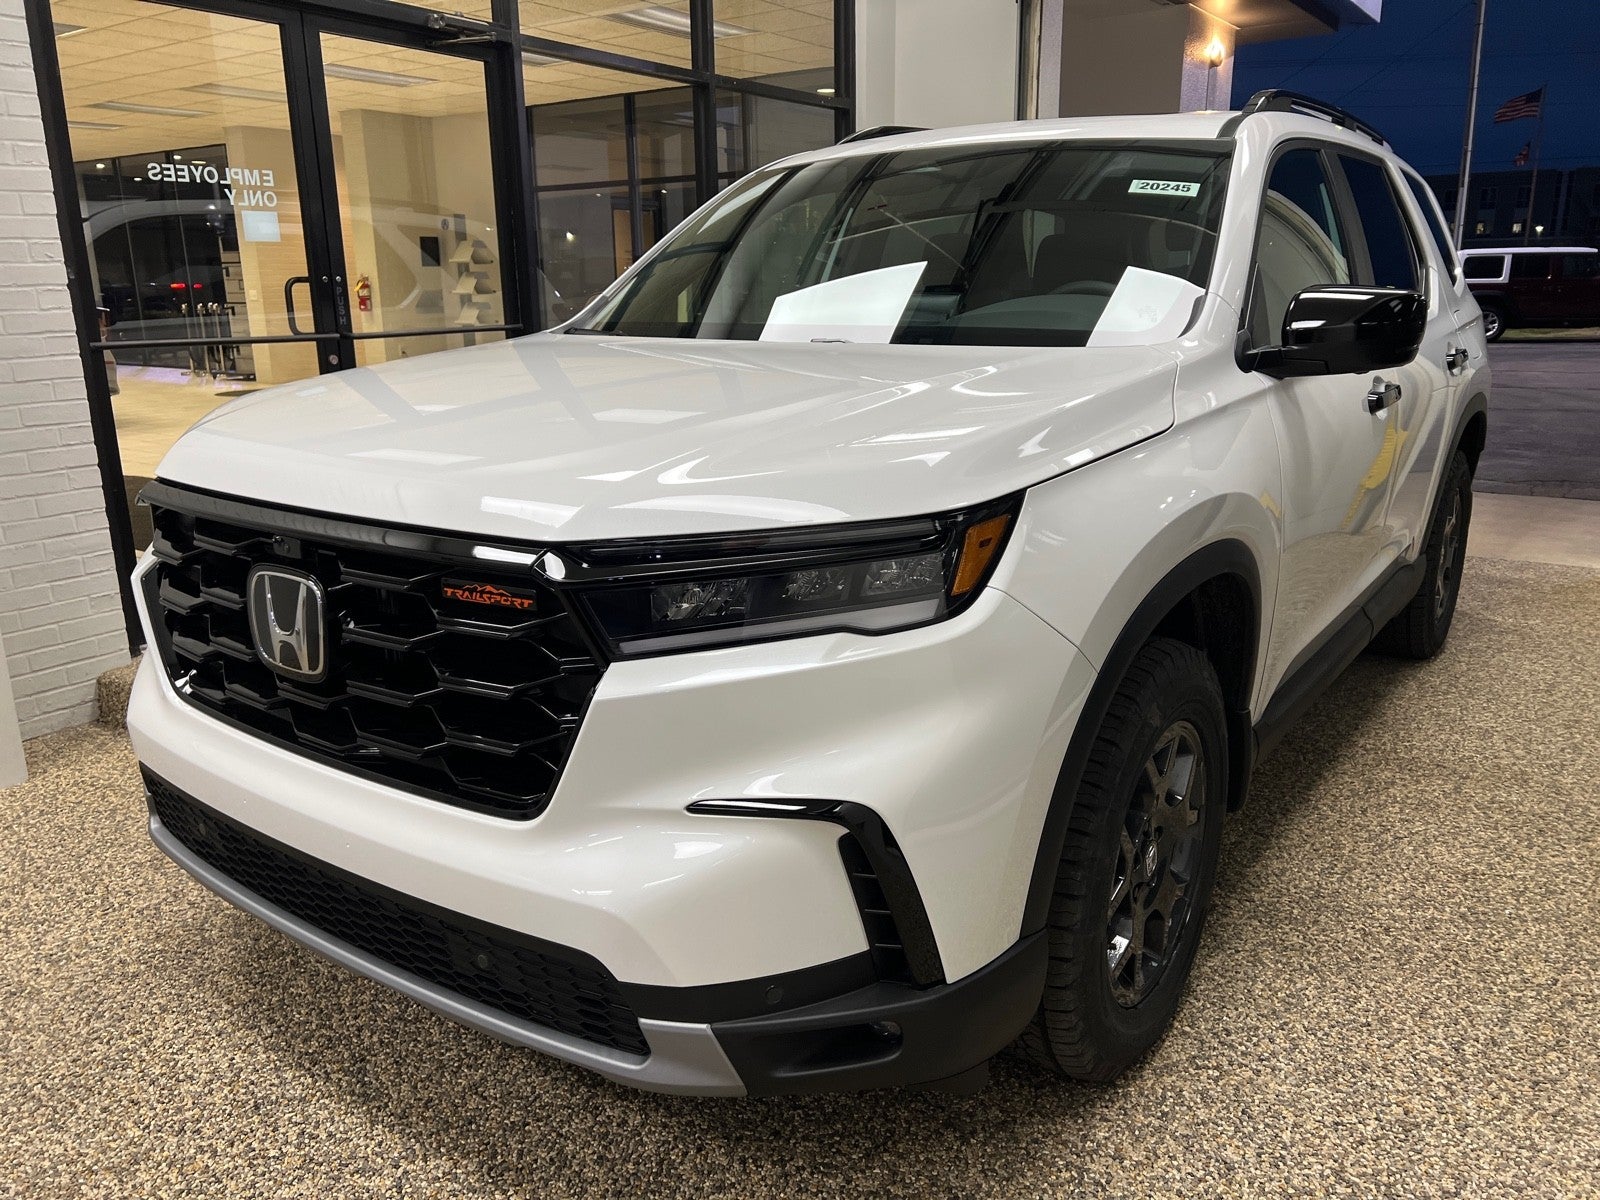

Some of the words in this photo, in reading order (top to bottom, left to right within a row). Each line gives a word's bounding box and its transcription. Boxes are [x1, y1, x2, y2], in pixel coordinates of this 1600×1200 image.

[1138, 181, 1192, 193] 20245
[336, 286, 347, 325] PUSH
[443, 587, 534, 609] TRAILSPORT
